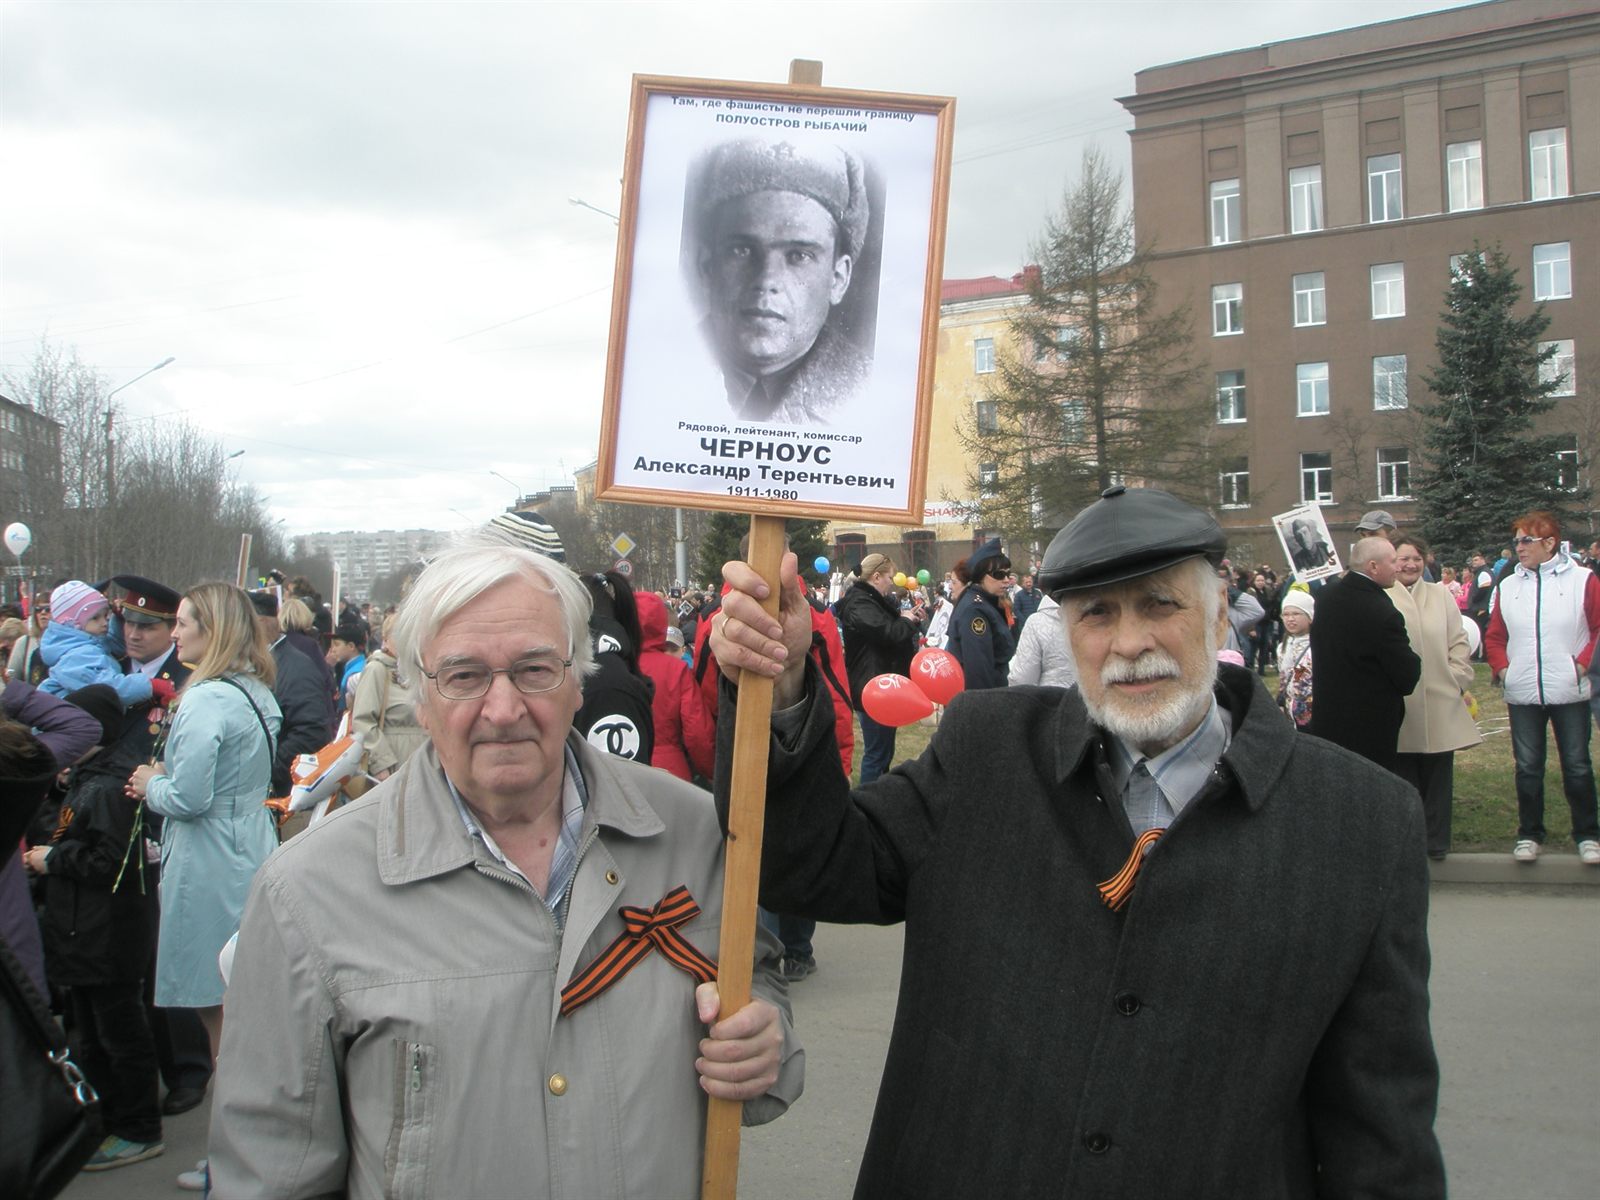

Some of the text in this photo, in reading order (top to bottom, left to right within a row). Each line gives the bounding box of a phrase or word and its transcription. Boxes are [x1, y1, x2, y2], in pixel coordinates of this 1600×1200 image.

[671, 96, 698, 107] Там,
[702, 99, 722, 108] где
[725, 100, 784, 112] фашисты
[806, 107, 861, 117] перешли
[865, 110, 915, 122] границу
[716, 113, 868, 133] ПОЛУОСТРОВ РЫБАЧИЙ
[678, 421, 863, 444] Рядовой, лейтенант, комиссар
[700, 437, 832, 465] ЧЕРНОУС
[633, 456, 896, 489] Александр Терентьевич
[727, 485, 799, 501] 1911-1980
